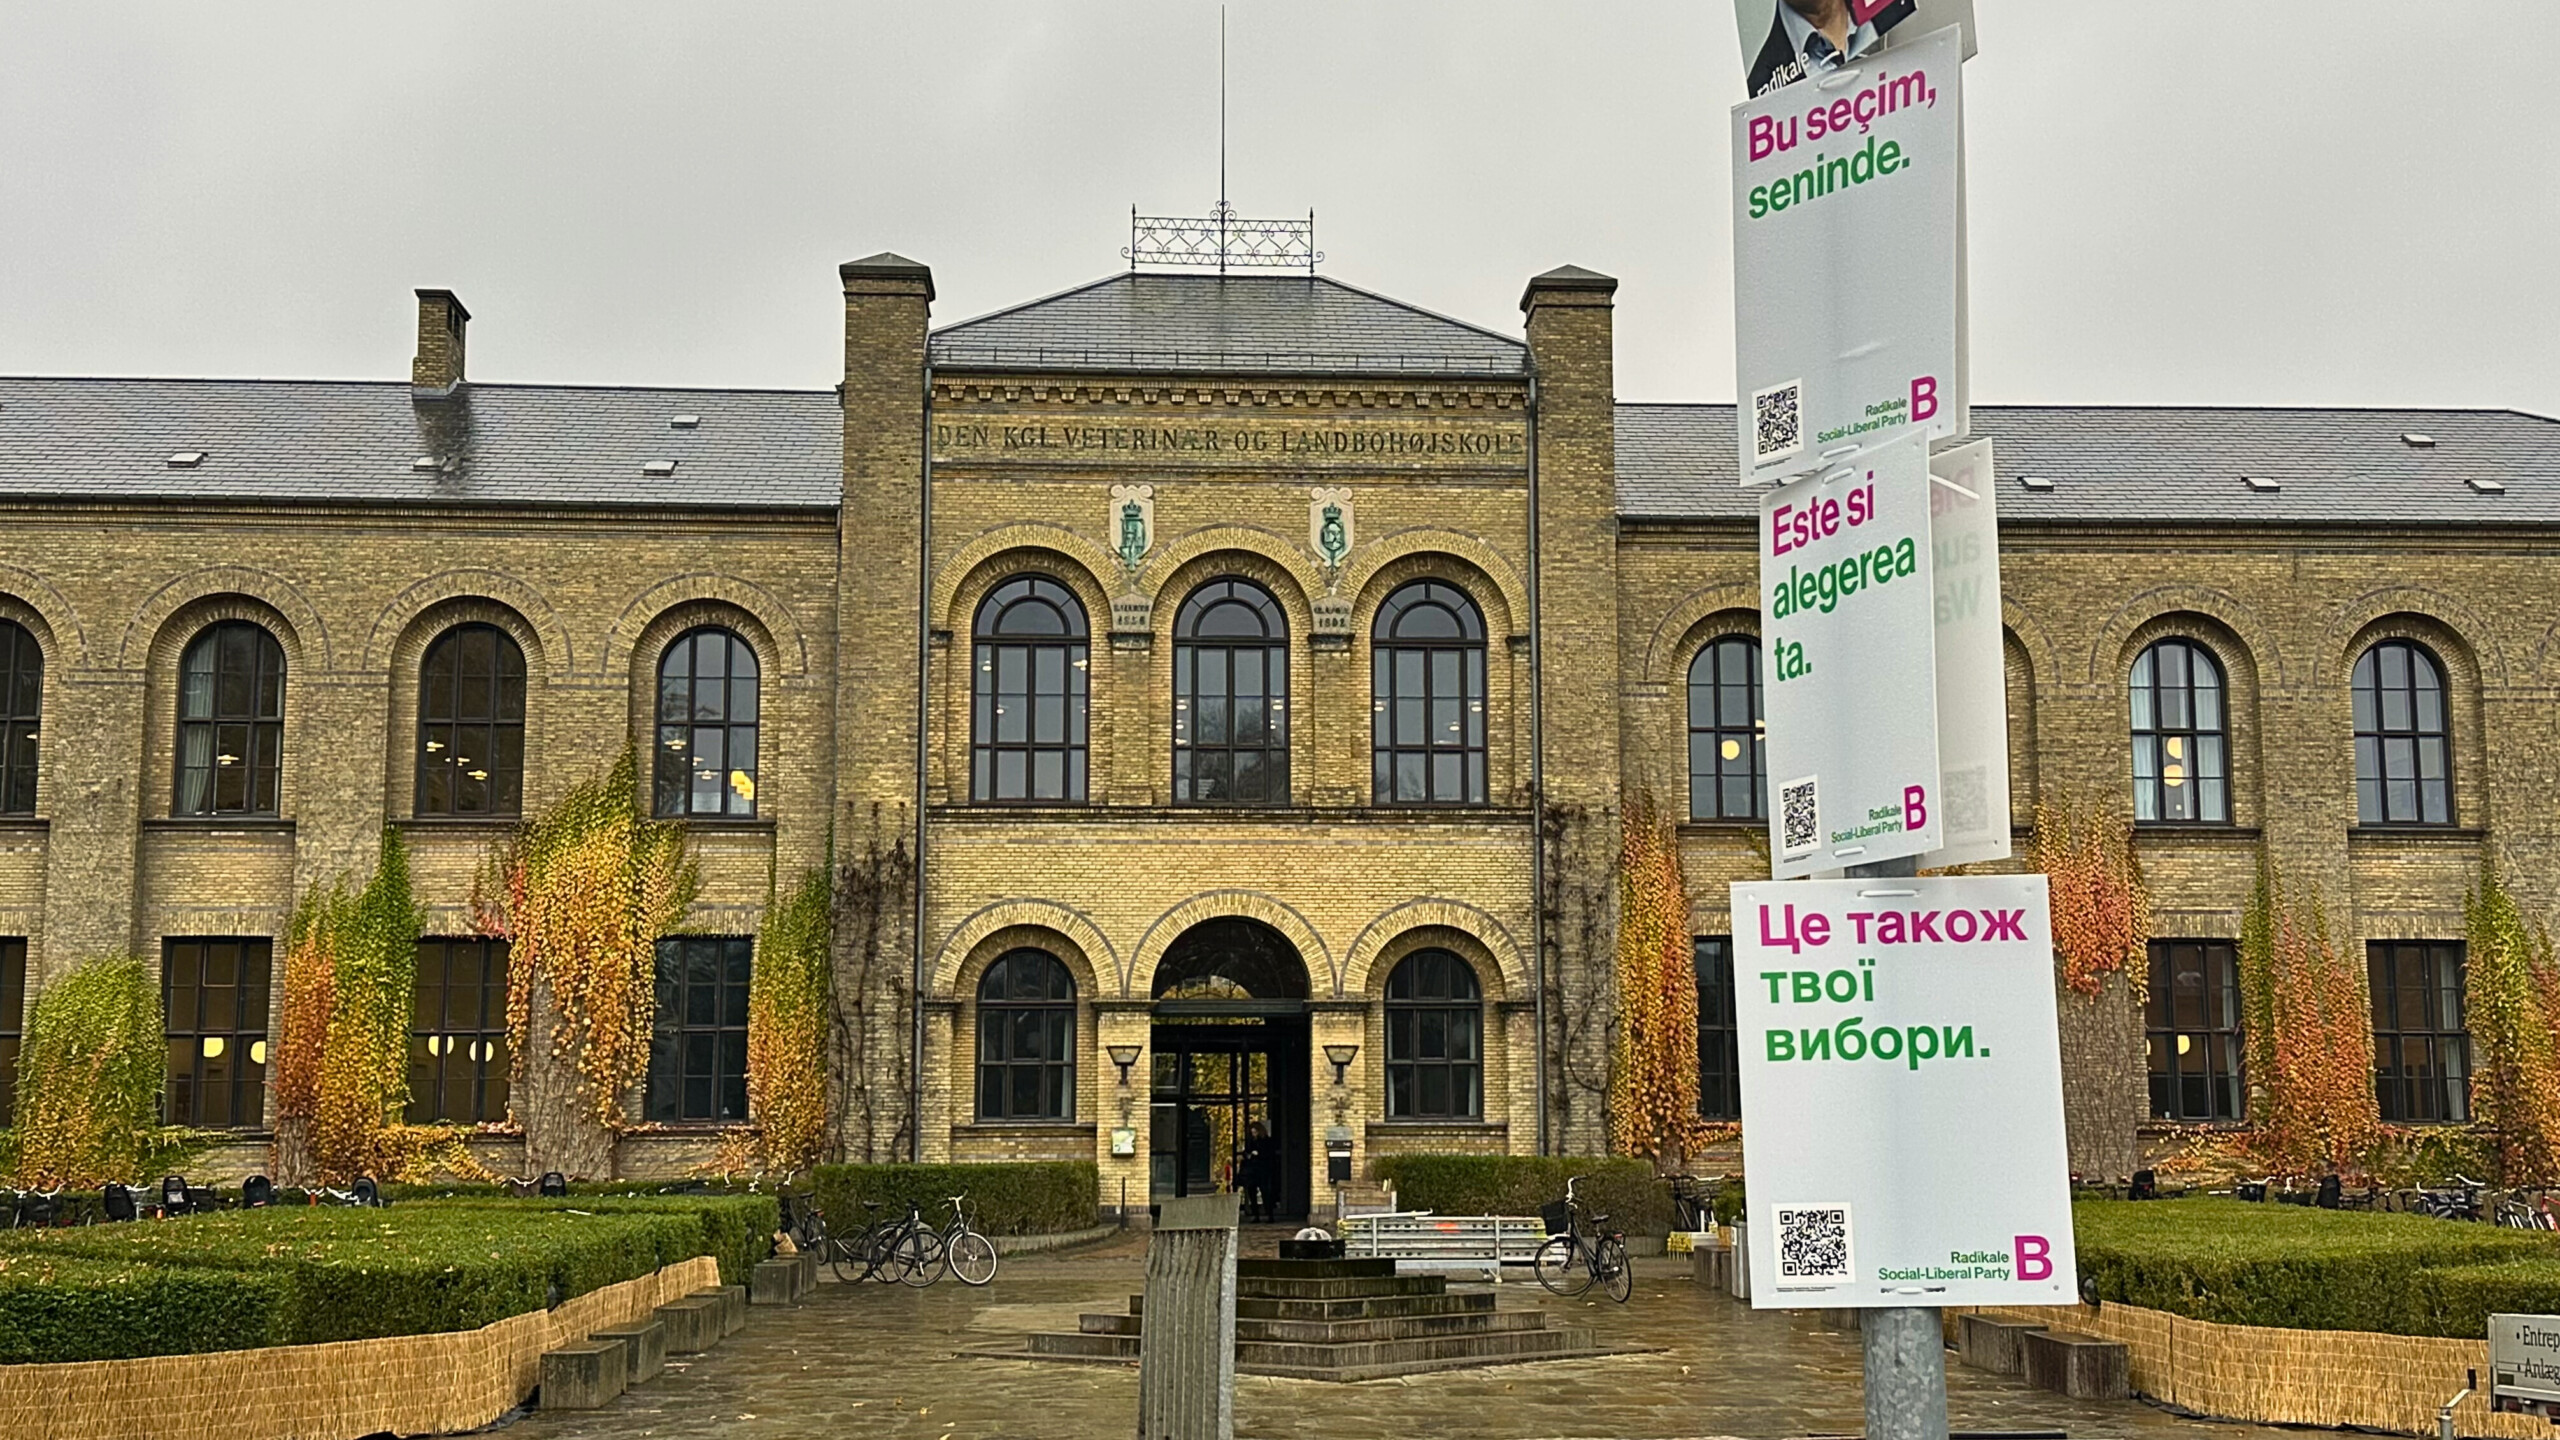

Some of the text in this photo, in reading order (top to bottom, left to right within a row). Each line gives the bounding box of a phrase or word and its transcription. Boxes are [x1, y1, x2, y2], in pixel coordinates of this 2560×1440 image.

[1748, 70, 1937, 162] Bu seçim,
[1748, 136, 1910, 219] seninde.
[1865, 397, 1907, 417] Radikale
[1911, 376, 1938, 422] B
[936, 425, 989, 448] DEN
[1234, 430, 1268, 452] OG
[1281, 430, 1523, 454] LANDBOHØJSKOLE
[1817, 413, 1908, 443] Social-Liberal Party
[1772, 470, 1875, 557] Este si
[1773, 537, 1916, 620] alegerea
[1773, 637, 1812, 683] ta.
[1868, 804, 1902, 821] Radikale
[1882, 820, 1903, 833] Party
[1904, 785, 1927, 831] B
[1758, 903, 2029, 955] Це також
[1760, 958, 1876, 1004] твої
[1765, 1016, 1991, 1071] вибори.
[1878, 1266, 2011, 1281] Social-Liberal Party
[1951, 1251, 2010, 1264] Radikale
[2014, 1235, 2054, 1281] B
[2523, 1324, 2560, 1352] Entrep
